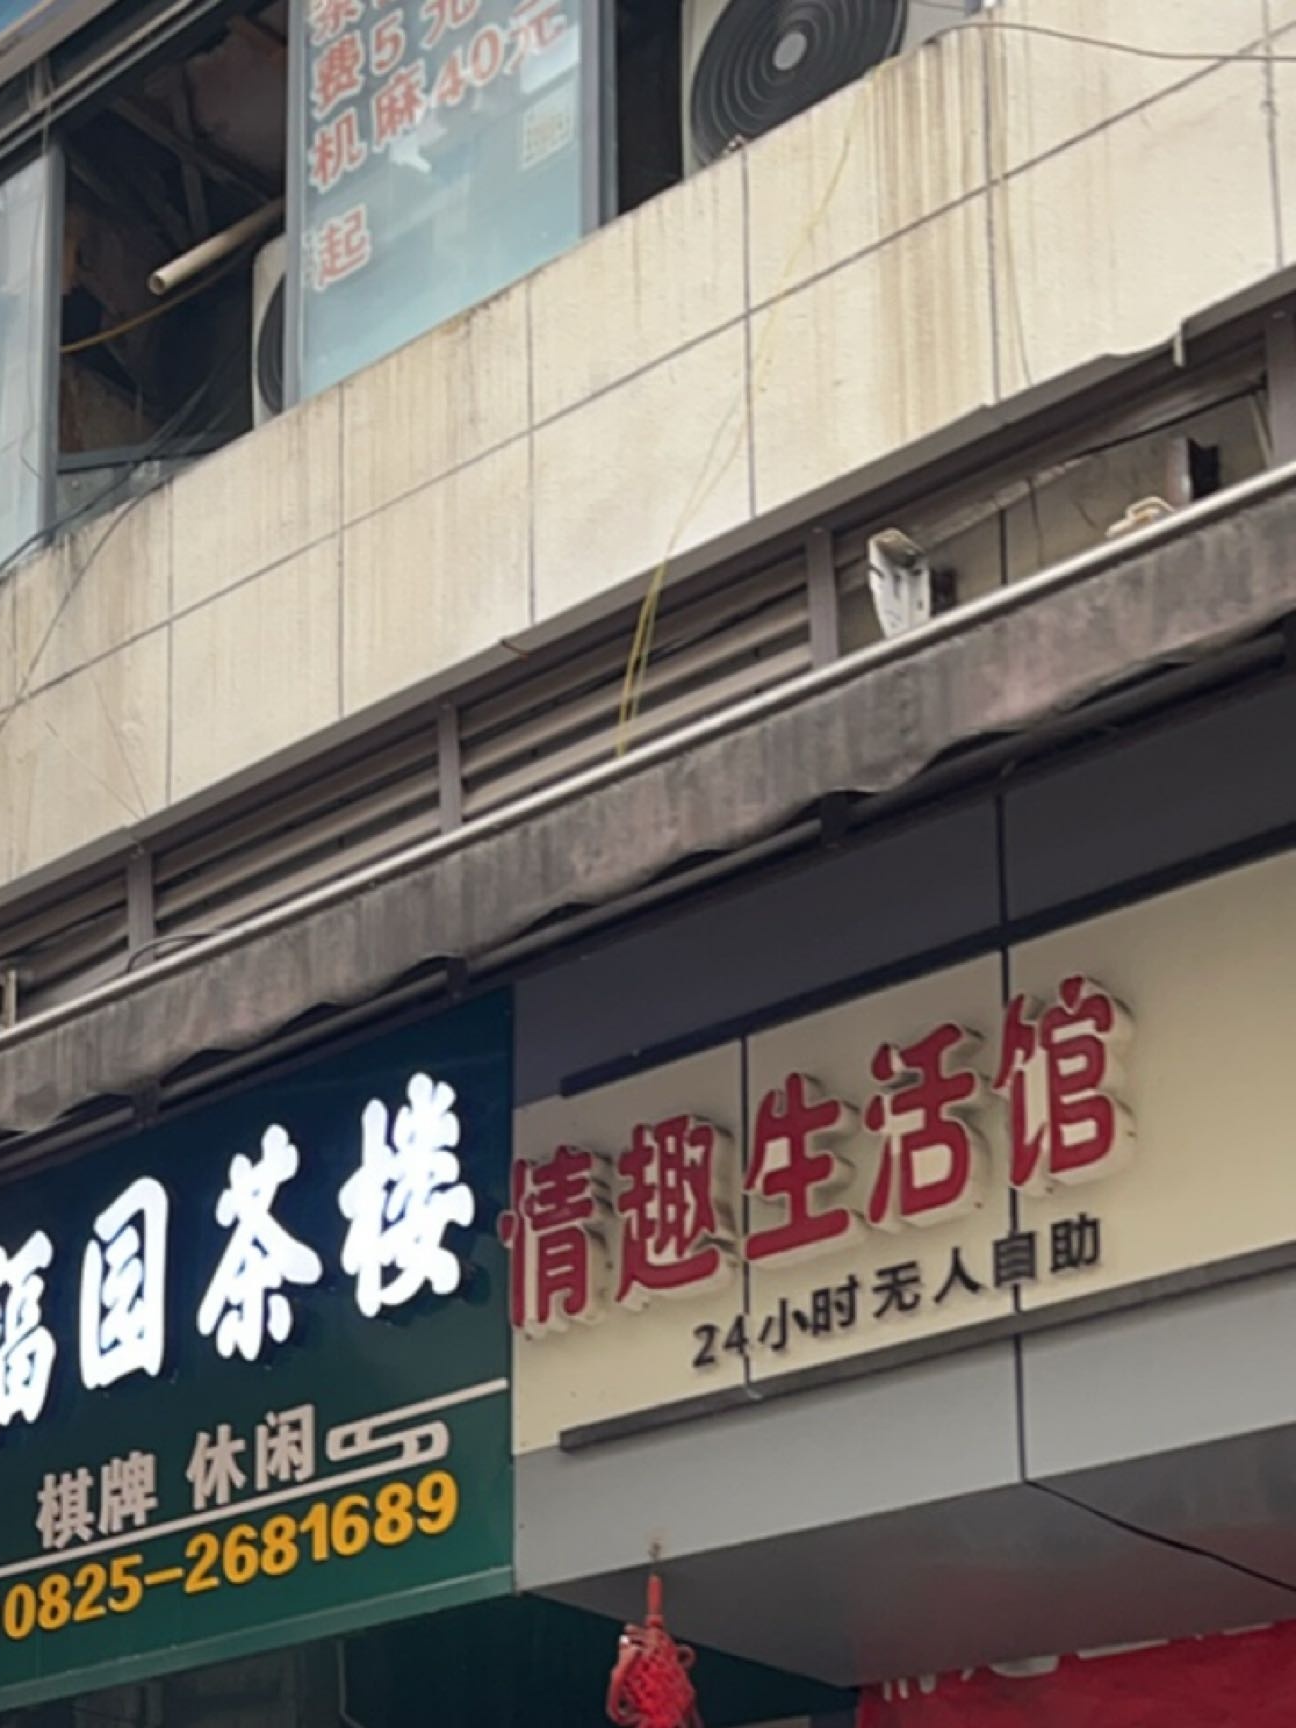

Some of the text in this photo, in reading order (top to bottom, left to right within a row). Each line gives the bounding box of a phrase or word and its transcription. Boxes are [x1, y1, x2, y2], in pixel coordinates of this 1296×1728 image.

[312, 203, 371, 290] 起
[499, 974, 1120, 1338] 情趣生活馆
[692, 1214, 1102, 1369] 24小时无人自助
[36, 1451, 159, 1550] 棋牌
[186, 1404, 315, 1509] 休闲
